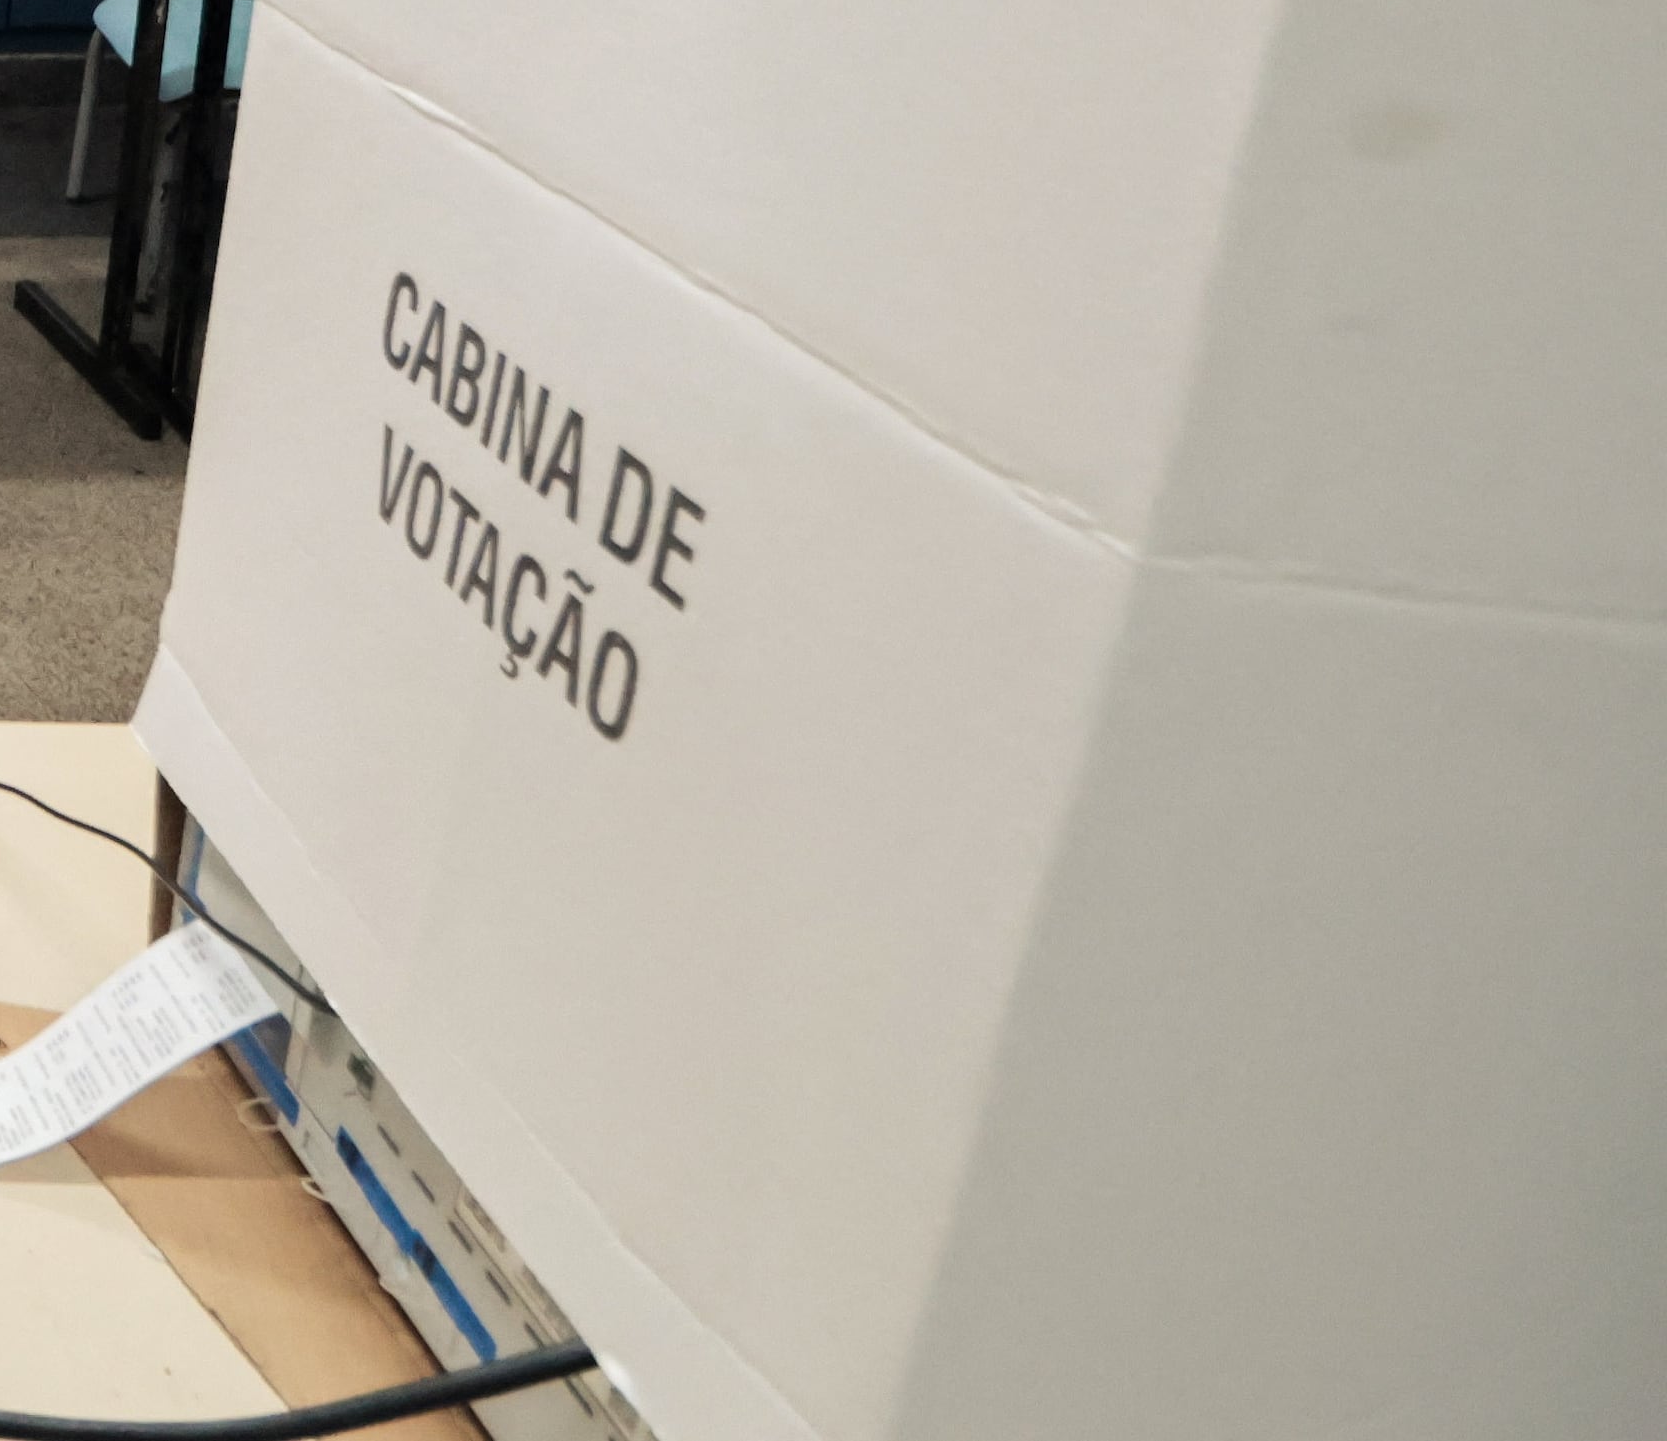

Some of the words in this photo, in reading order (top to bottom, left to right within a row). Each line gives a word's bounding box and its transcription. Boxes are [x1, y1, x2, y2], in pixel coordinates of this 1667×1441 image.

[378, 424, 639, 743] VOTAÇÃO
[382, 272, 586, 524] CABINA
[597, 445, 707, 612] DE
